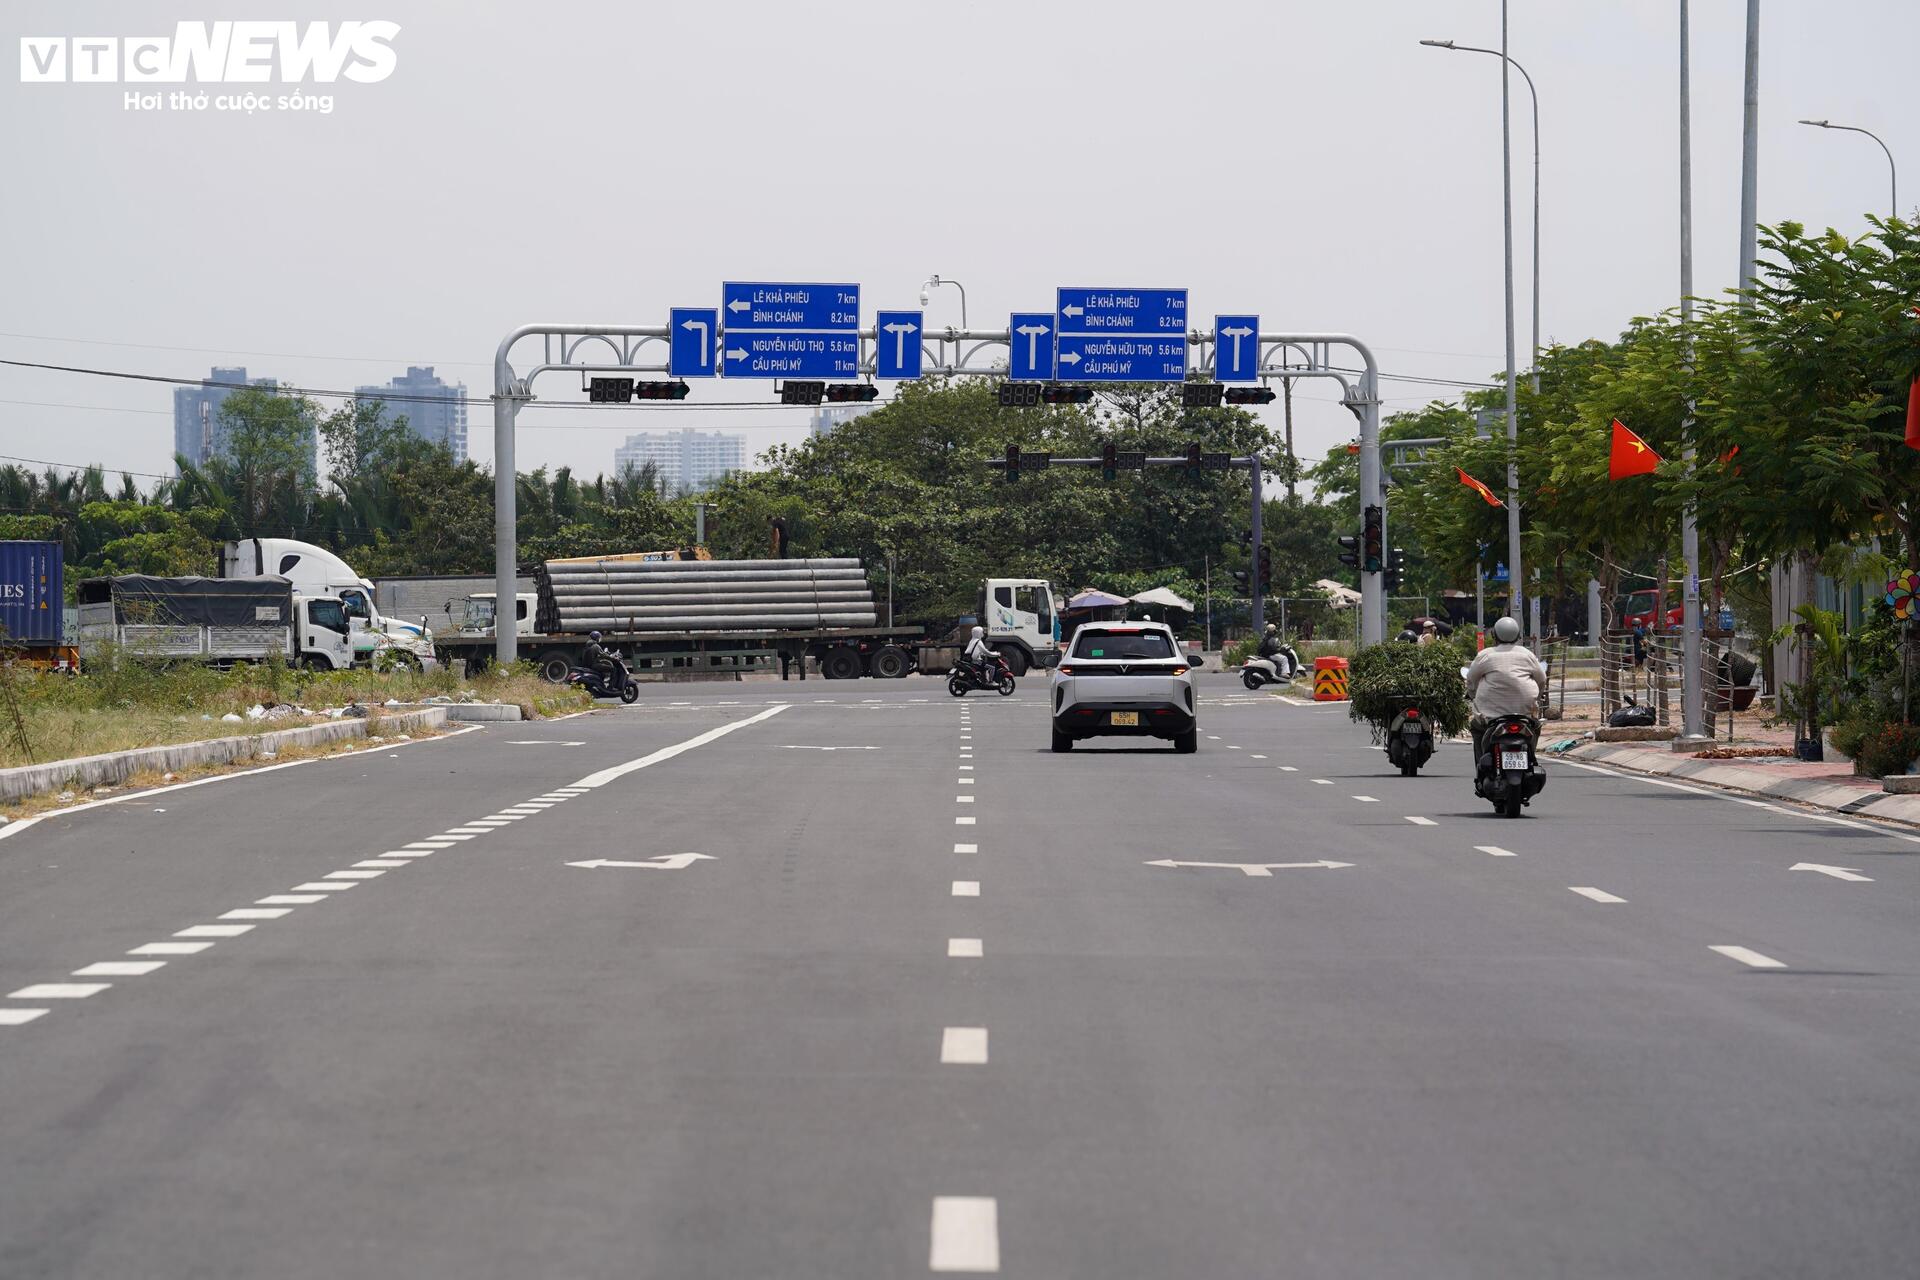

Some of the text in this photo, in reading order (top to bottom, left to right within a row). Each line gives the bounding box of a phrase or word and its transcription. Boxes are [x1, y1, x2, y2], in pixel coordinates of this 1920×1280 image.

[754, 289, 856, 303] LÊ KHẢ PHIÊU 7 km
[1087, 294, 1184, 308] LÊ KHẢ PHIÊU 7 km
[754, 309, 856, 323] BÌNH CHÁNH 8.2 km
[1086, 314, 1183, 327] BÌNH CHÁNH 8.2 km
[753, 337, 786, 351] NGUYỄN
[808, 341, 824, 353] THỌ
[831, 341, 841, 351] 5.6
[844, 341, 855, 351] km
[1085, 340, 1116, 354] NGUYỄN
[1137, 345, 1152, 356] THỌ
[1159, 345, 1169, 355] 5.6
[1172, 345, 1183, 355] km
[753, 356, 855, 370] CẦU PHÚ MỸ 11 km
[1085, 359, 1182, 373] CẦU PHÚ MỸ 11 km
[0, 584, 24, 598] ES
